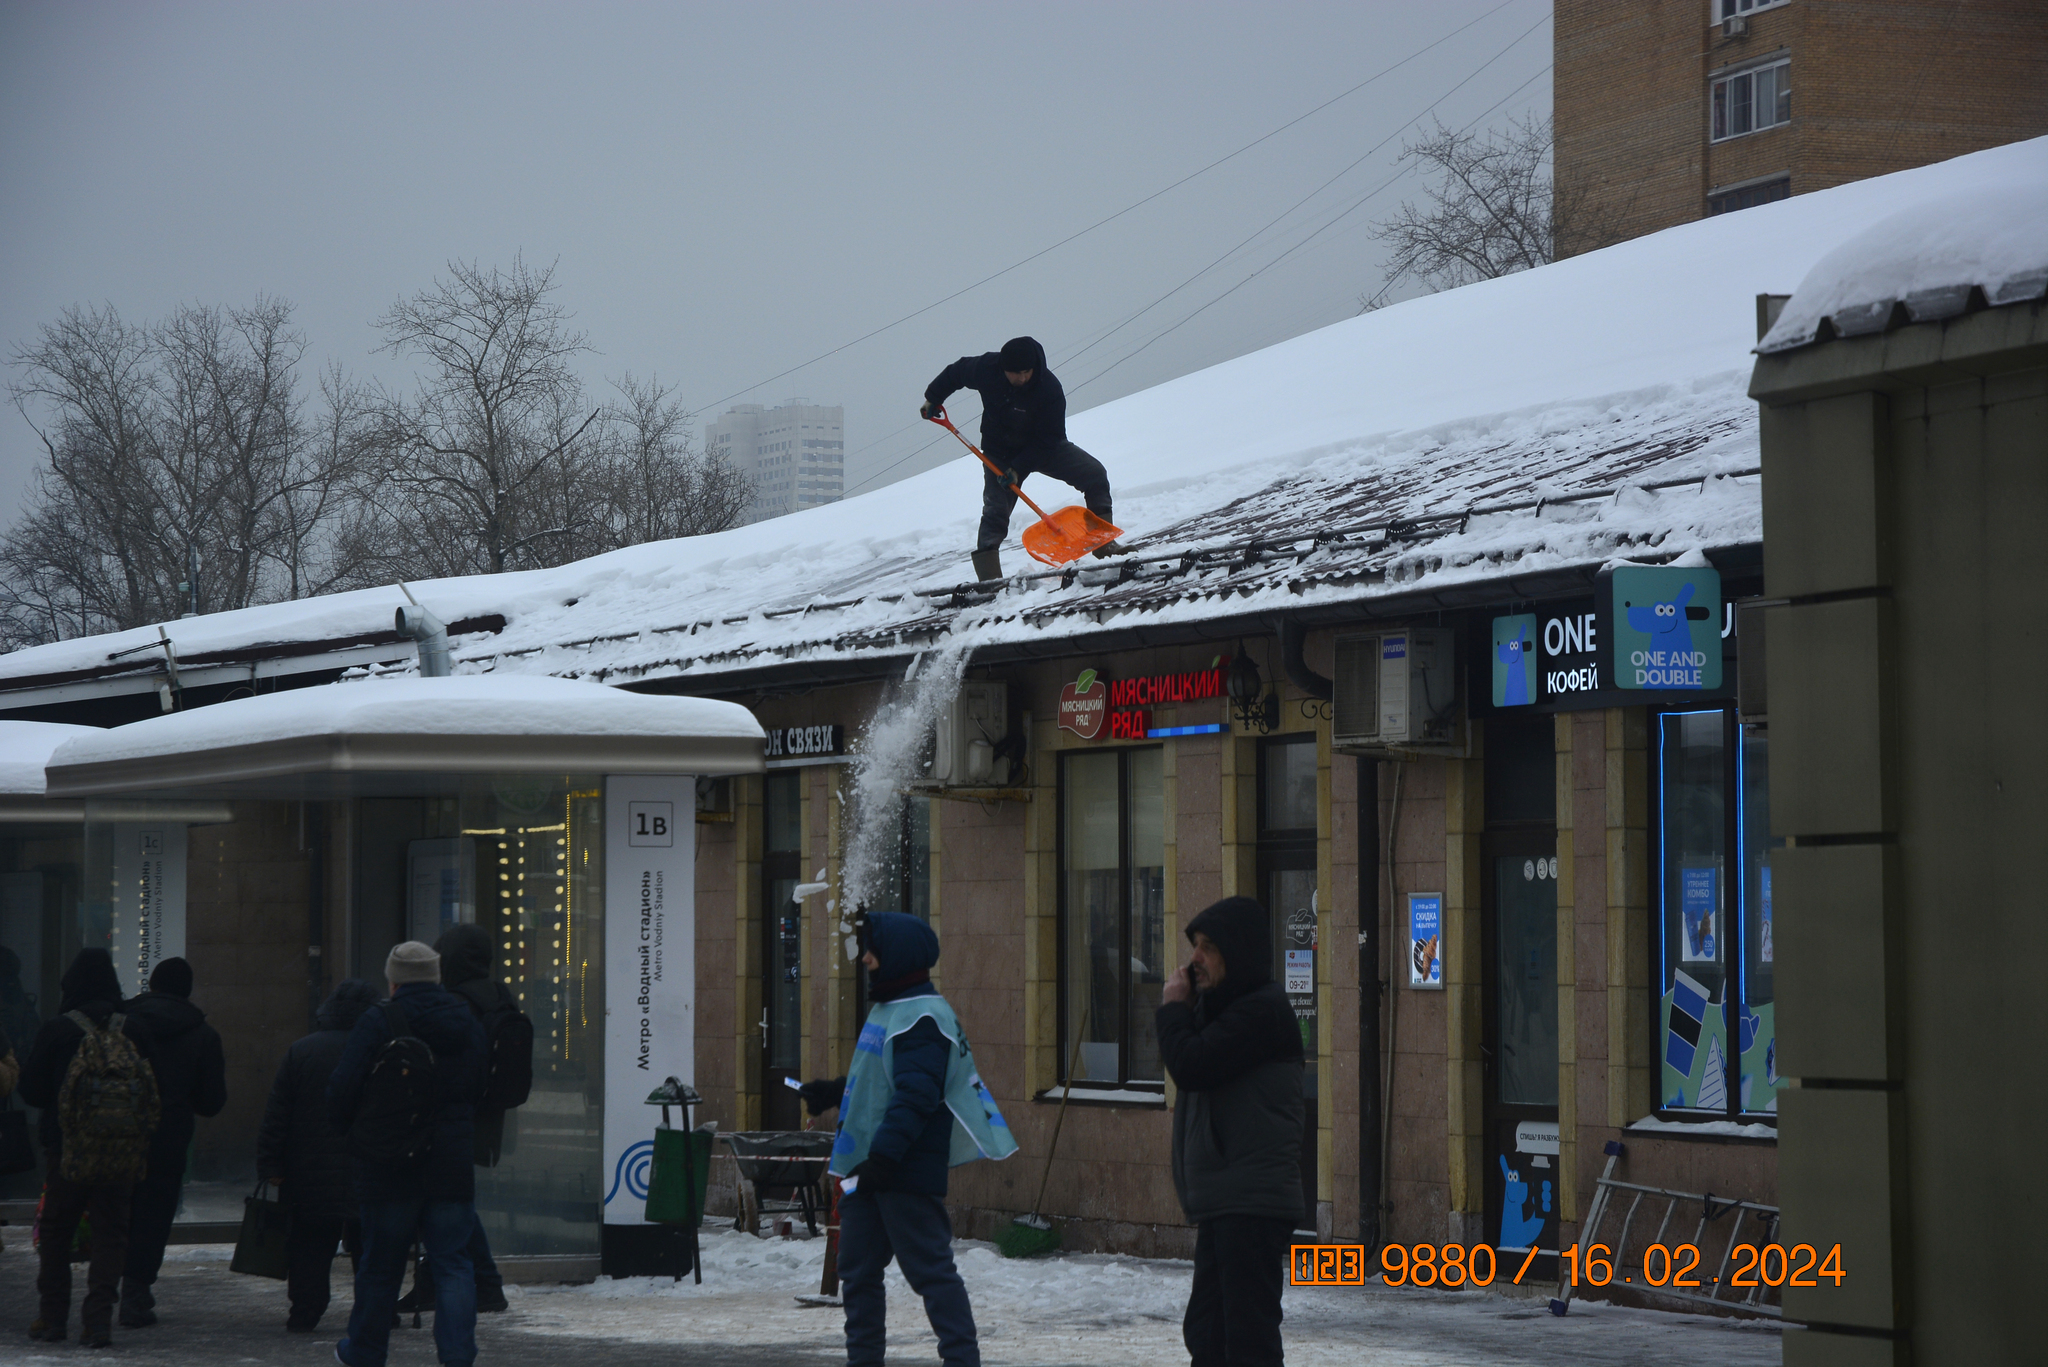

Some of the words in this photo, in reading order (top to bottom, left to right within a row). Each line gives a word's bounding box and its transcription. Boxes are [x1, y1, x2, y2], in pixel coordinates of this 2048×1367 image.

[1544, 613, 1597, 656] ONE
[1630, 651, 1667, 667] ONE
[1669, 651, 1707, 667] AND
[1111, 667, 1220, 707] МЯСНИЦКИЙ
[1635, 669, 1703, 686] DOUBLE
[1061, 694, 1103, 713] МЯСНИЦКИЙ
[787, 725, 833, 754] СВЯЗИ
[1111, 710, 1145, 740] РЯД
[154, 861, 163, 896] Stadion
[654, 870, 664, 909] Stadion
[1687, 888, 1710, 898] КОМБО
[640, 870, 653, 941] стадион»
[1415, 912, 1437, 922] СКИДКА
[154, 931, 163, 959] Metro
[654, 912, 665, 949] Vodniy
[637, 946, 653, 1015] «Водный
[654, 950, 663, 982] Metro
[637, 1018, 653, 1070] Метро
